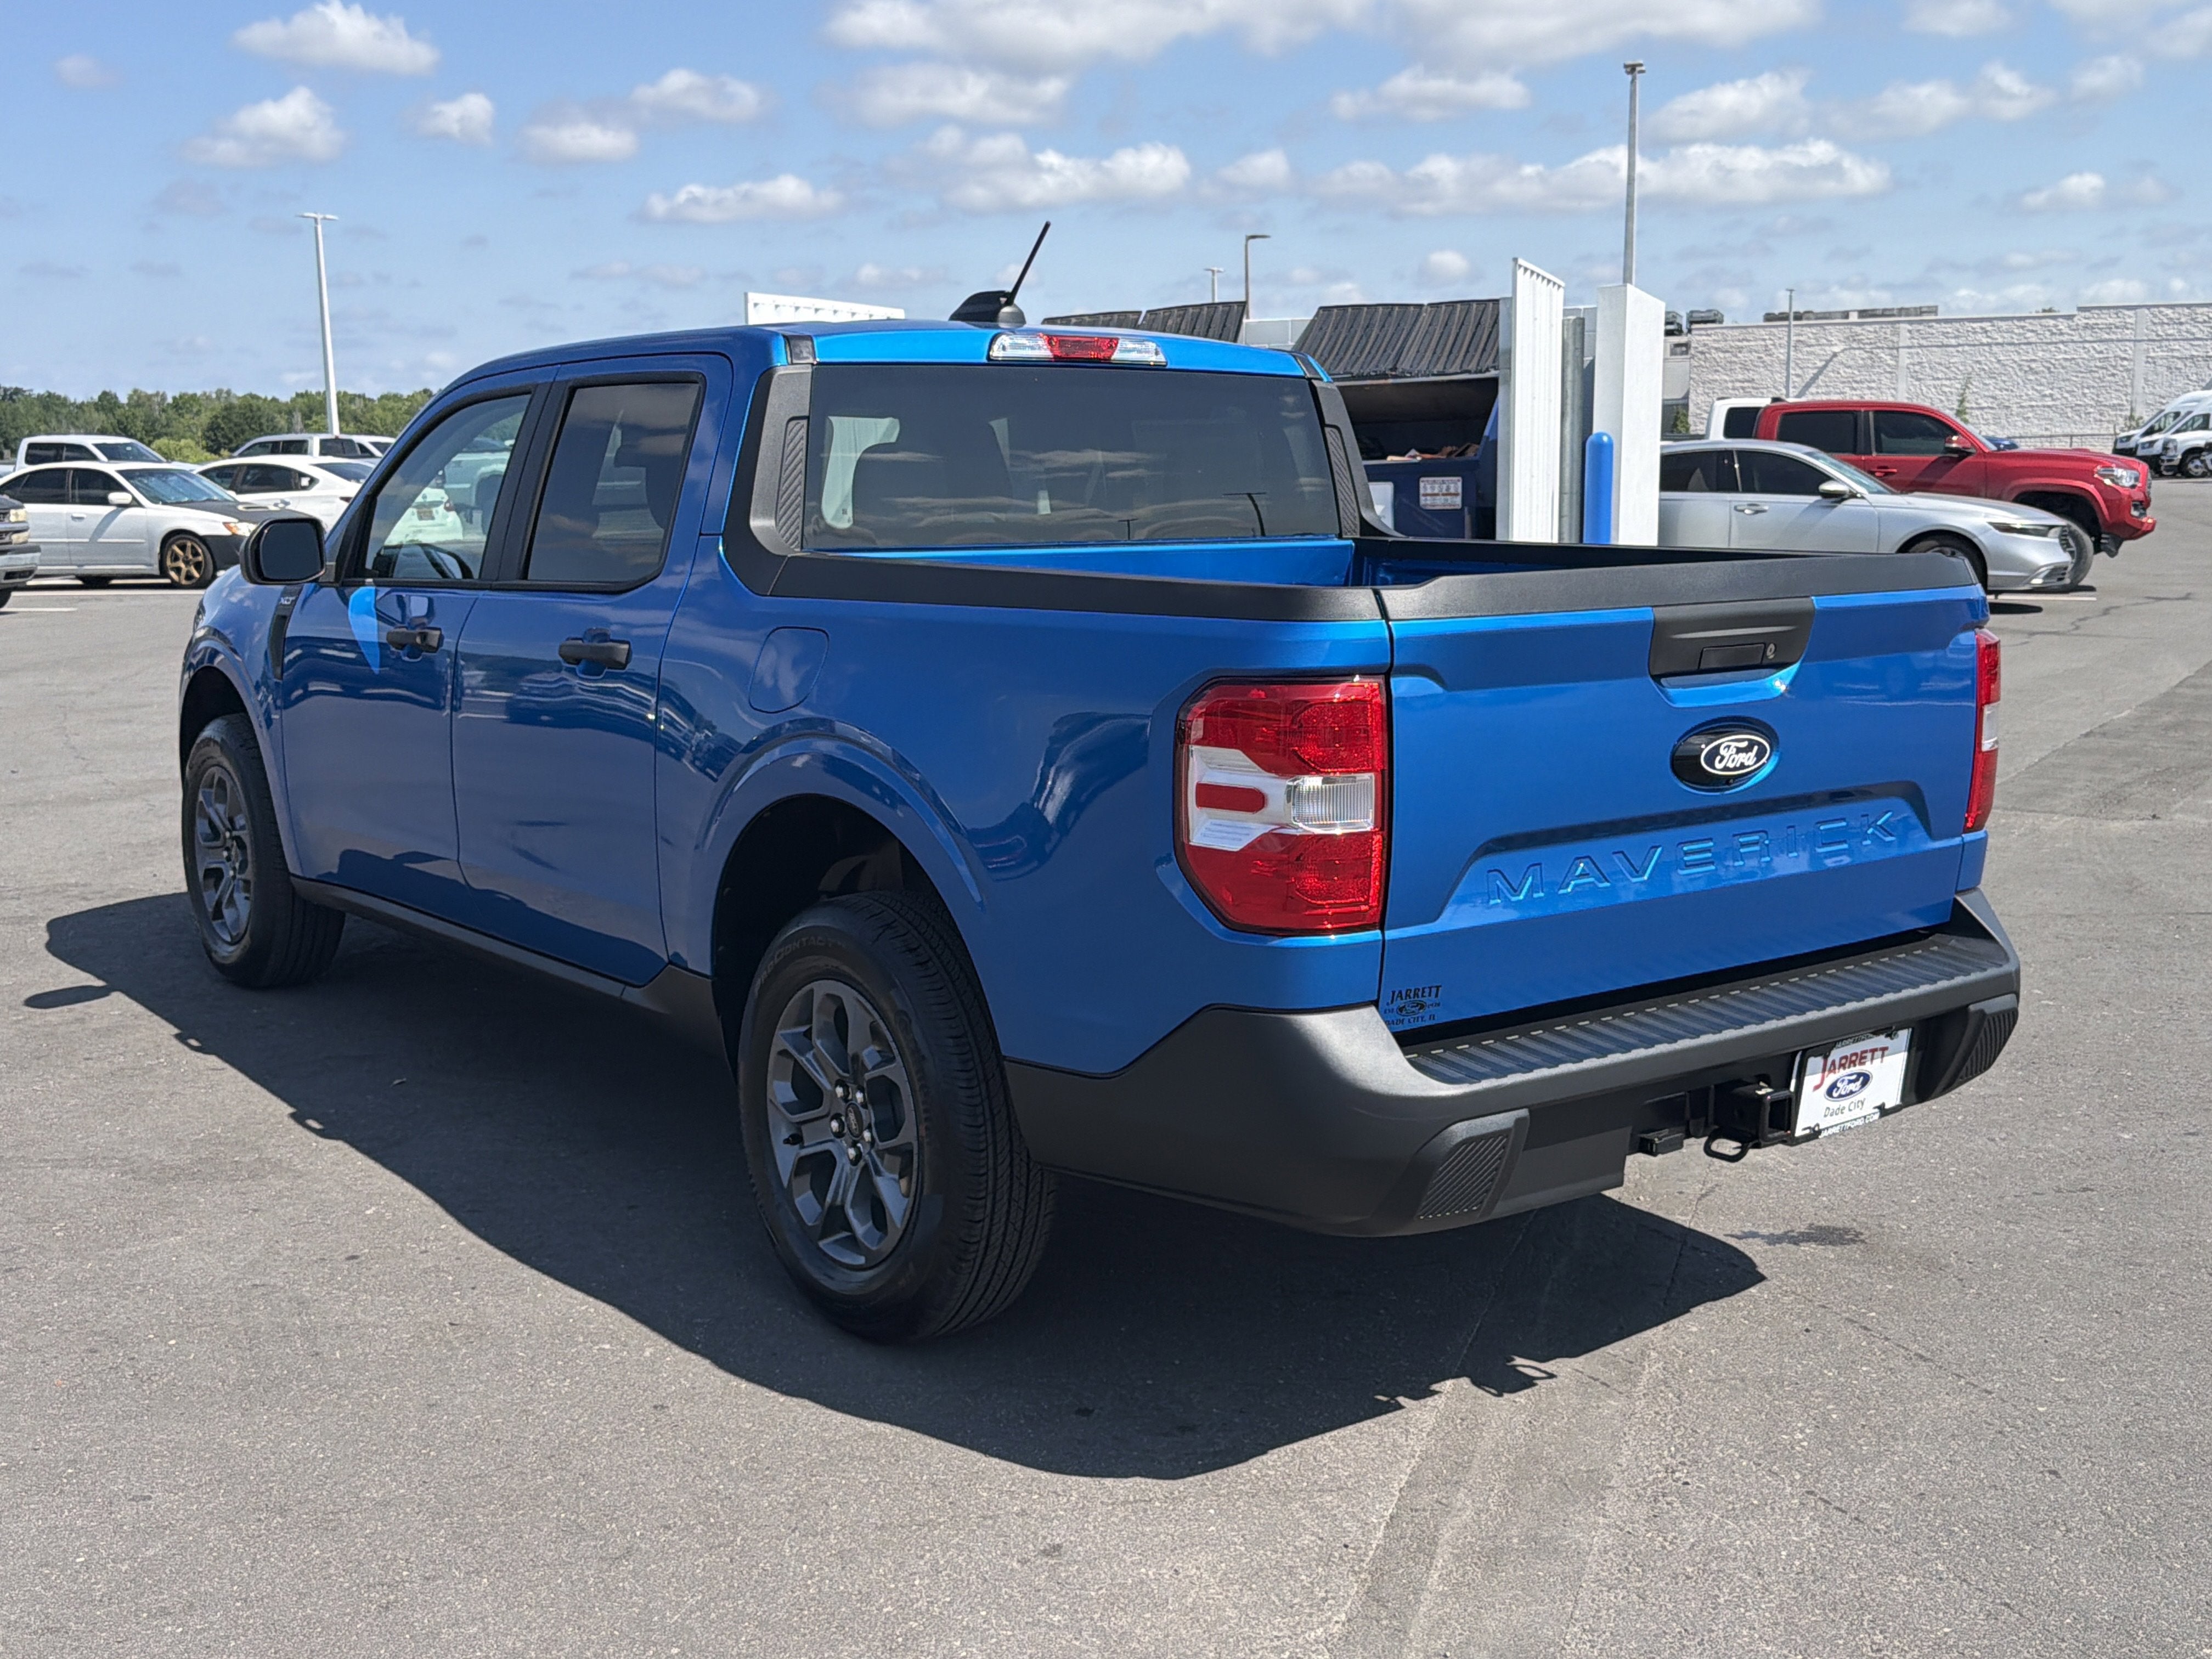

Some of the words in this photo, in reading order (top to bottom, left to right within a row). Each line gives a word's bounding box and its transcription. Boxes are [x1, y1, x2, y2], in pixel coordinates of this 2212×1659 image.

[1714, 741, 1758, 769] Ford
[1487, 810, 1898, 906] MAVERICK
[1390, 984, 1442, 1005] JARRETT
[1813, 1046, 1889, 1092] JARRETT
[1832, 1074, 1863, 1097] Ford
[1824, 1103, 1846, 1118] Dade
[1848, 1098, 1866, 1112] City
